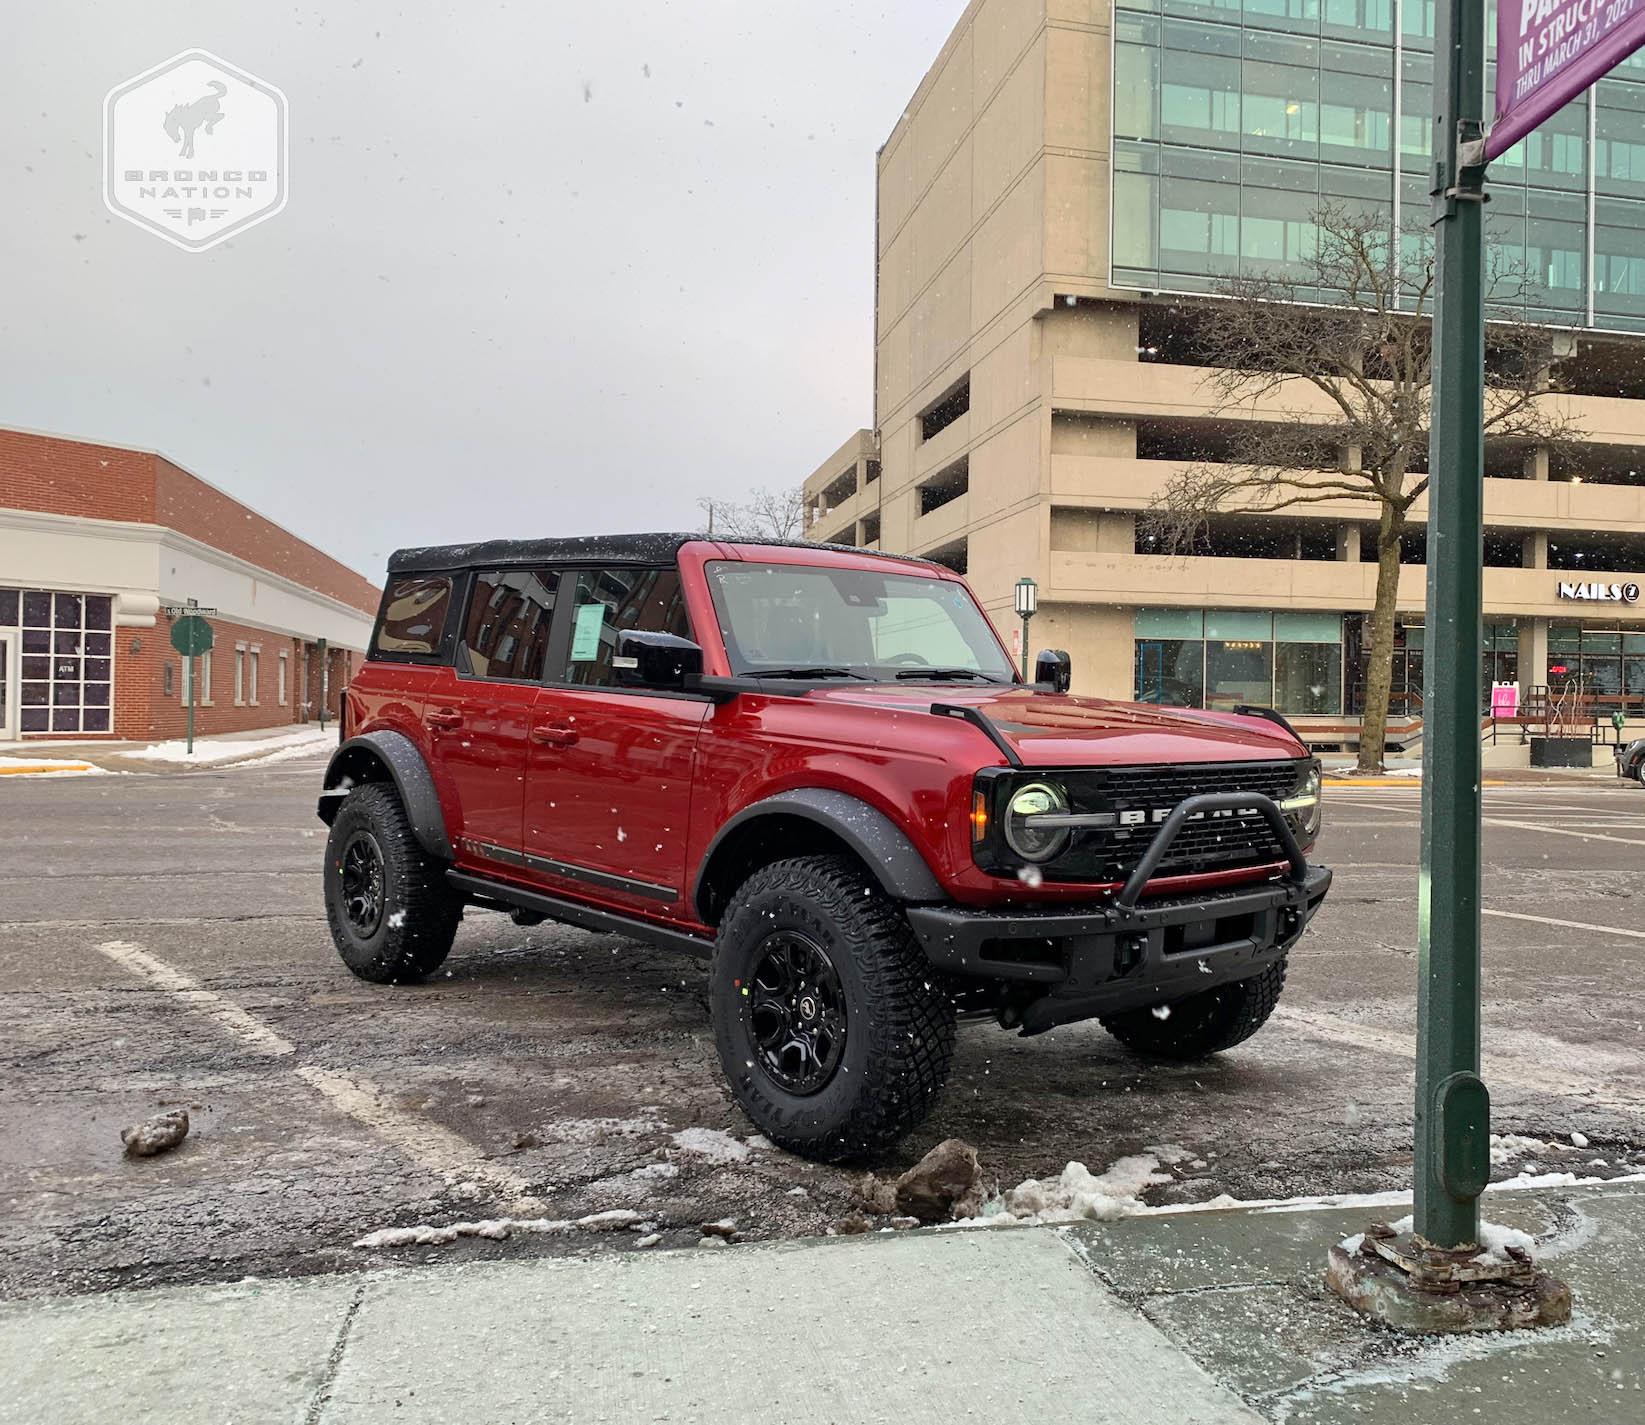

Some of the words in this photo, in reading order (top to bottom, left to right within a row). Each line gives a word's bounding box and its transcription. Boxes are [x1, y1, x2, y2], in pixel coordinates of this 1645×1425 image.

[1515, 61, 1542, 99] THRU
[1543, 31, 1581, 78] MARCH
[1583, 17, 1600, 46] 31,
[1519, 37, 1535, 72] IN
[1559, 583, 1622, 600] NAILS
